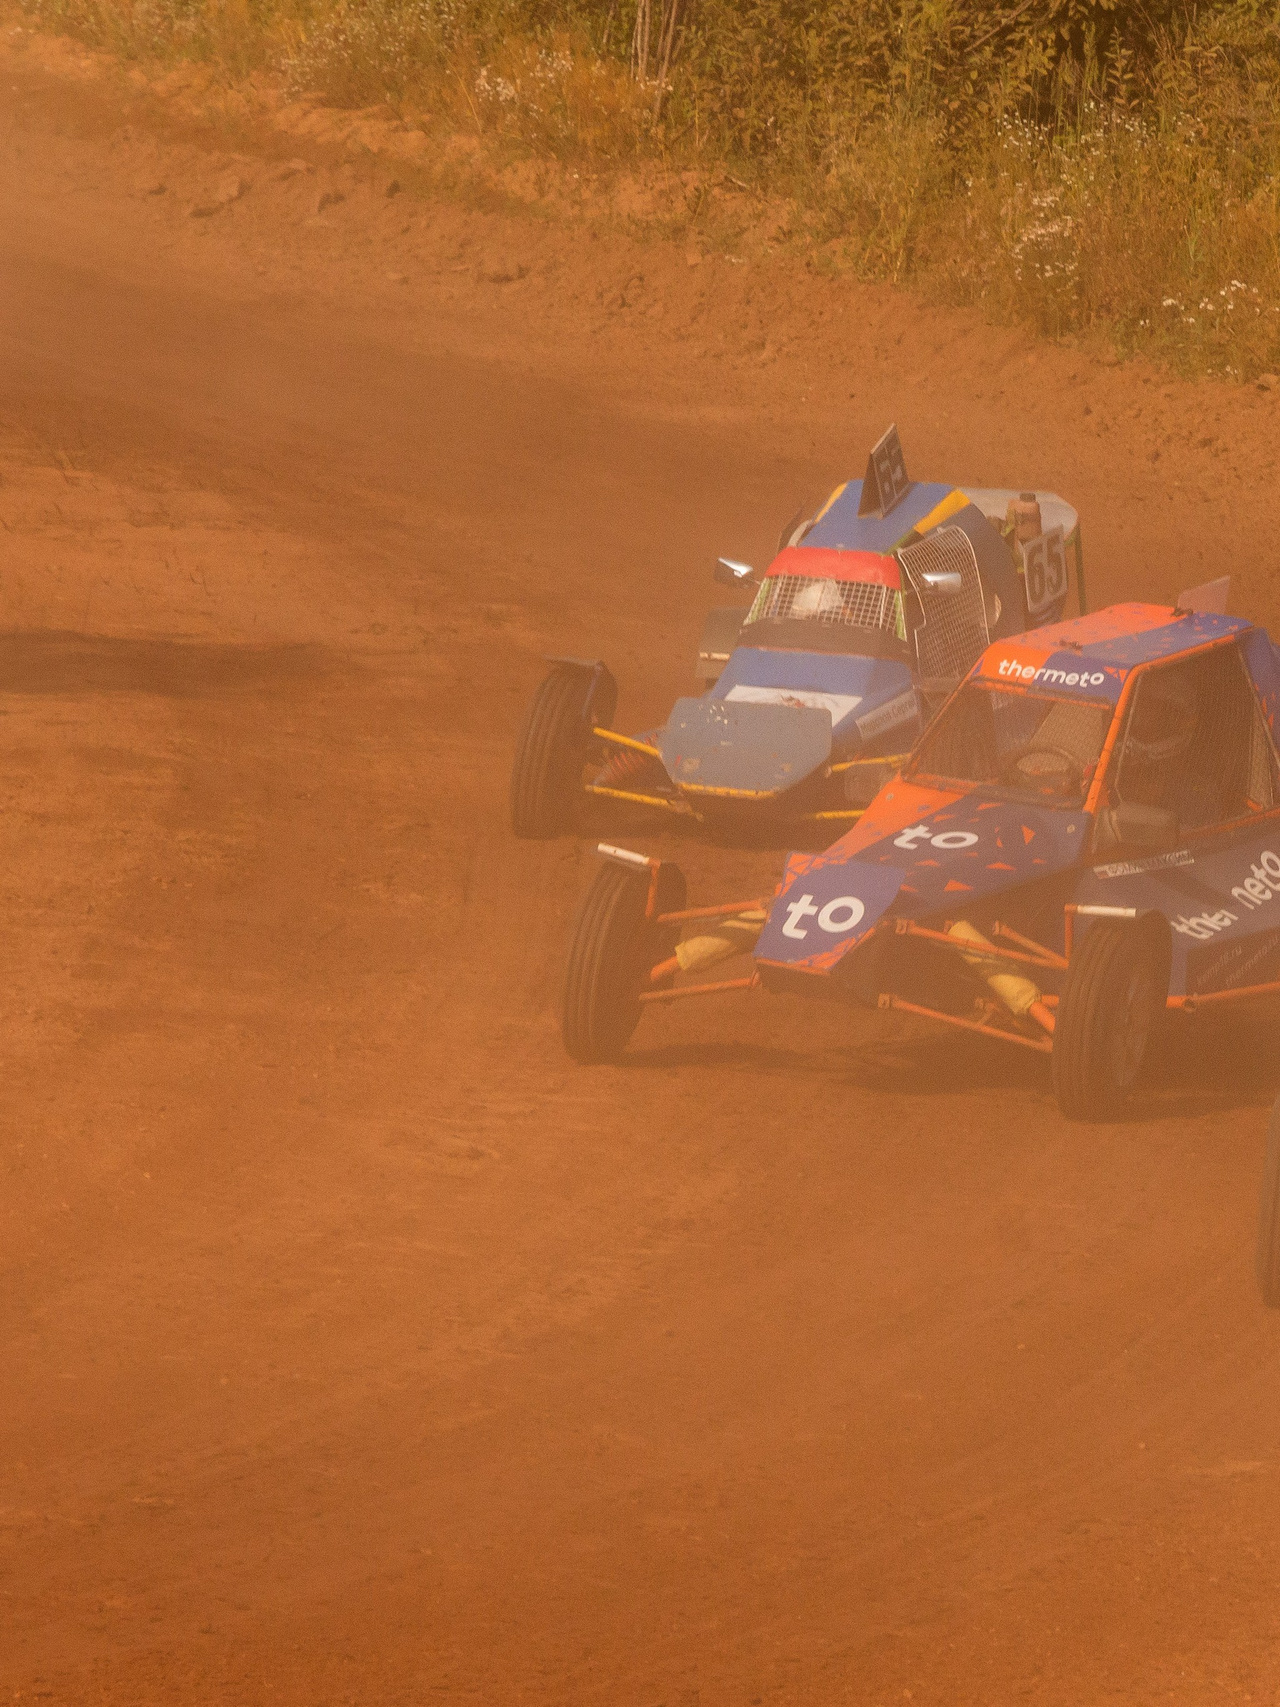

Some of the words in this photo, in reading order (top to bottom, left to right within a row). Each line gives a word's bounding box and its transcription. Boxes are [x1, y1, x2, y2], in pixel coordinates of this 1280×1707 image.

[1027, 533, 1063, 604] 65
[997, 659, 1105, 688] thermeto
[893, 824, 979, 850] to
[781, 893, 865, 940] to
